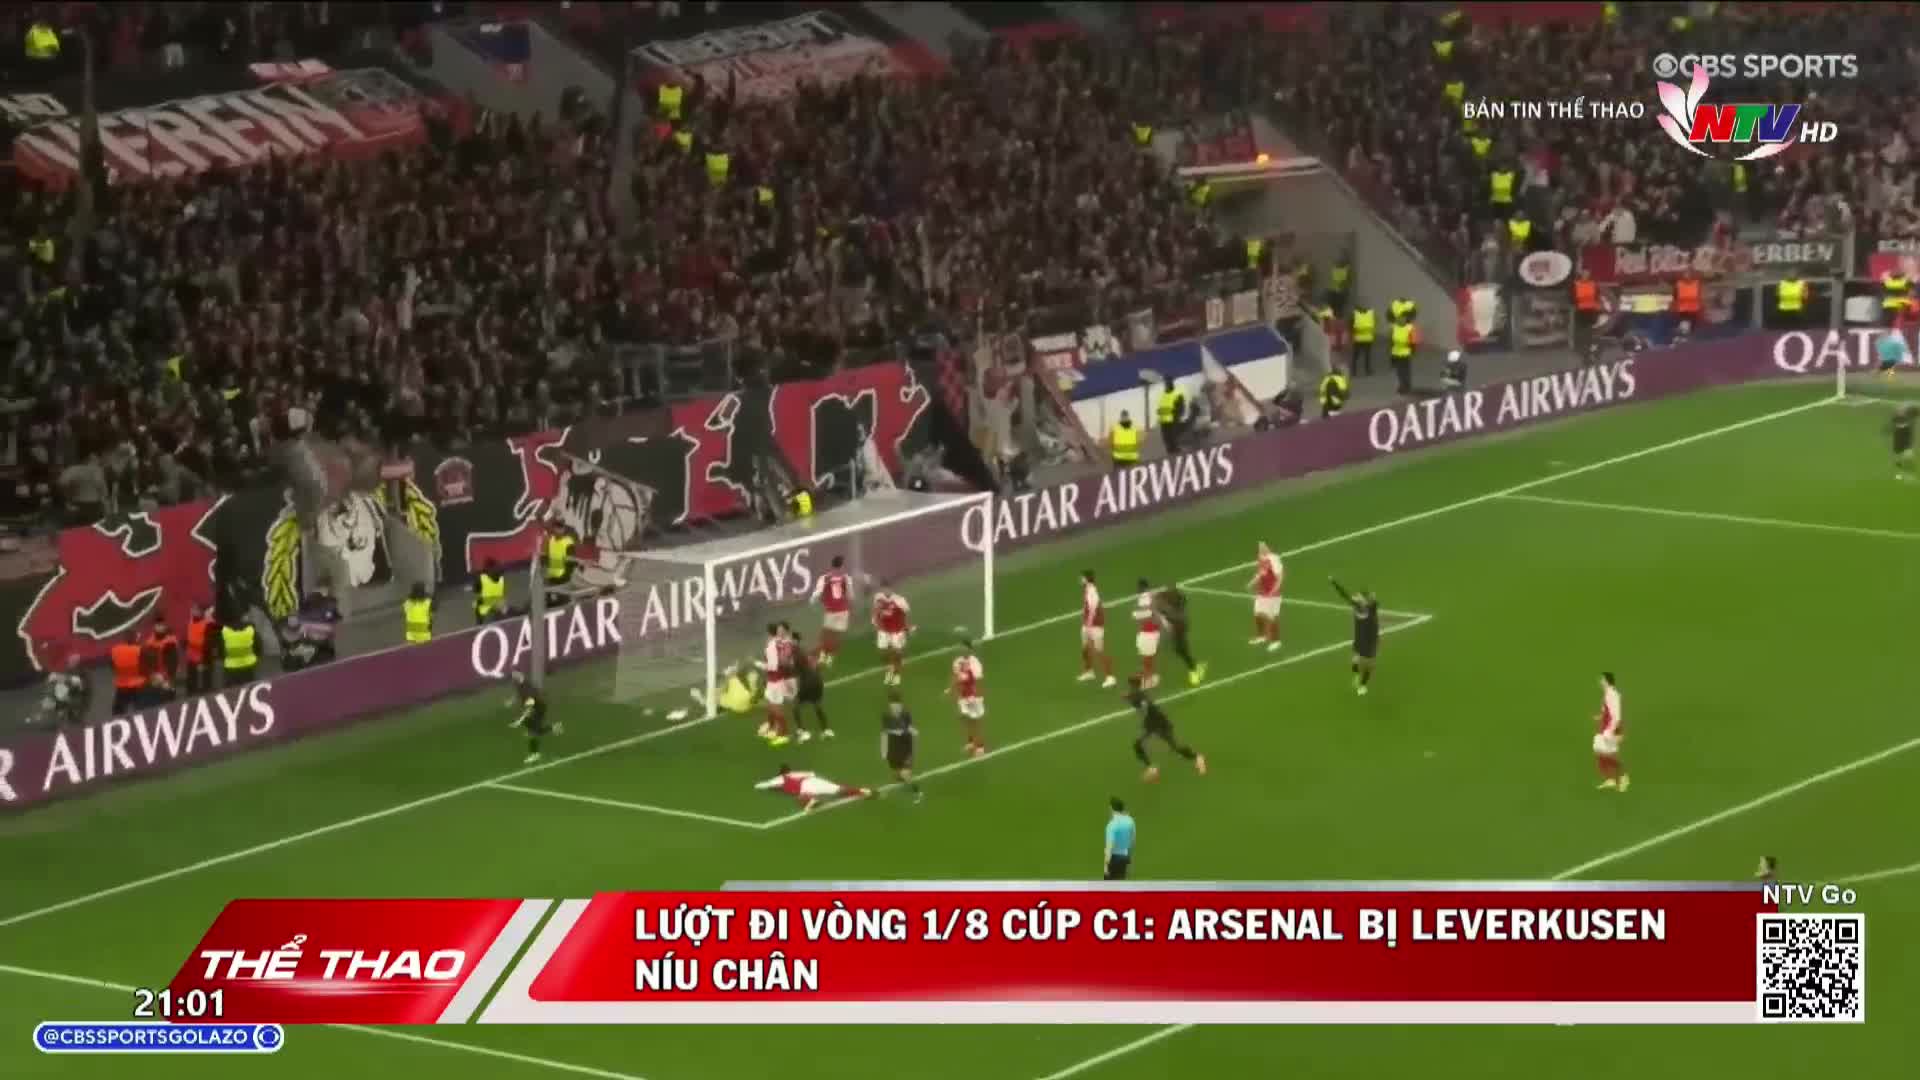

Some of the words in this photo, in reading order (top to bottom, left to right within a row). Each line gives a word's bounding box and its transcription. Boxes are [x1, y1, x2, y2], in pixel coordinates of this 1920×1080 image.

[1368, 390, 1485, 452] QATAR
[1496, 359, 1636, 425] AIRWAYS
[961, 482, 1080, 552] QATAR
[1094, 443, 1234, 518] AIRWAYS
[640, 547, 813, 637] AIRWAYS
[43, 681, 275, 791] AIRWAYS
